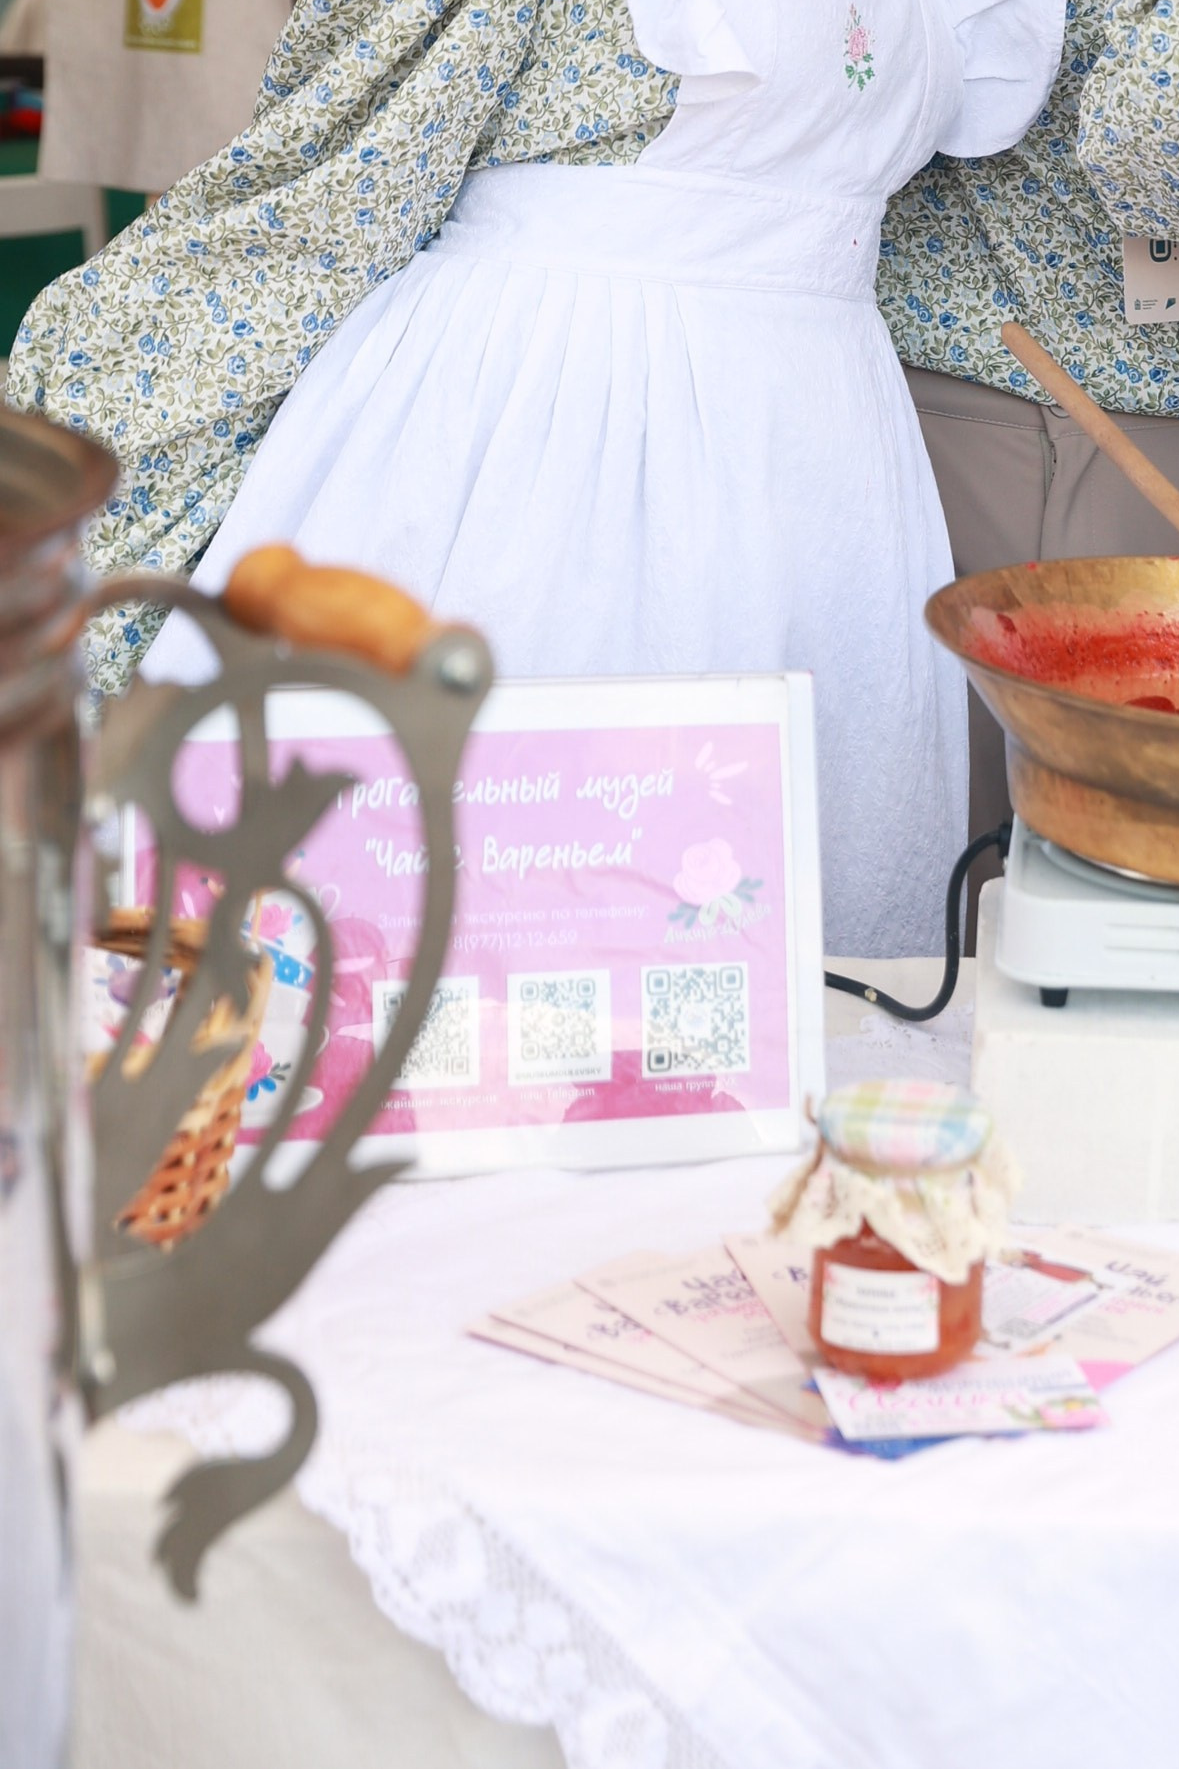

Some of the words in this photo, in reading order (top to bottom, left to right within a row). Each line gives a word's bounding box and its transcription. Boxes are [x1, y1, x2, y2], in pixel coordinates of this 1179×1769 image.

[337, 771, 561, 820] рогаельный
[576, 768, 675, 821] музей
[482, 827, 643, 878] Вареньем"
[551, 908, 570, 921] по
